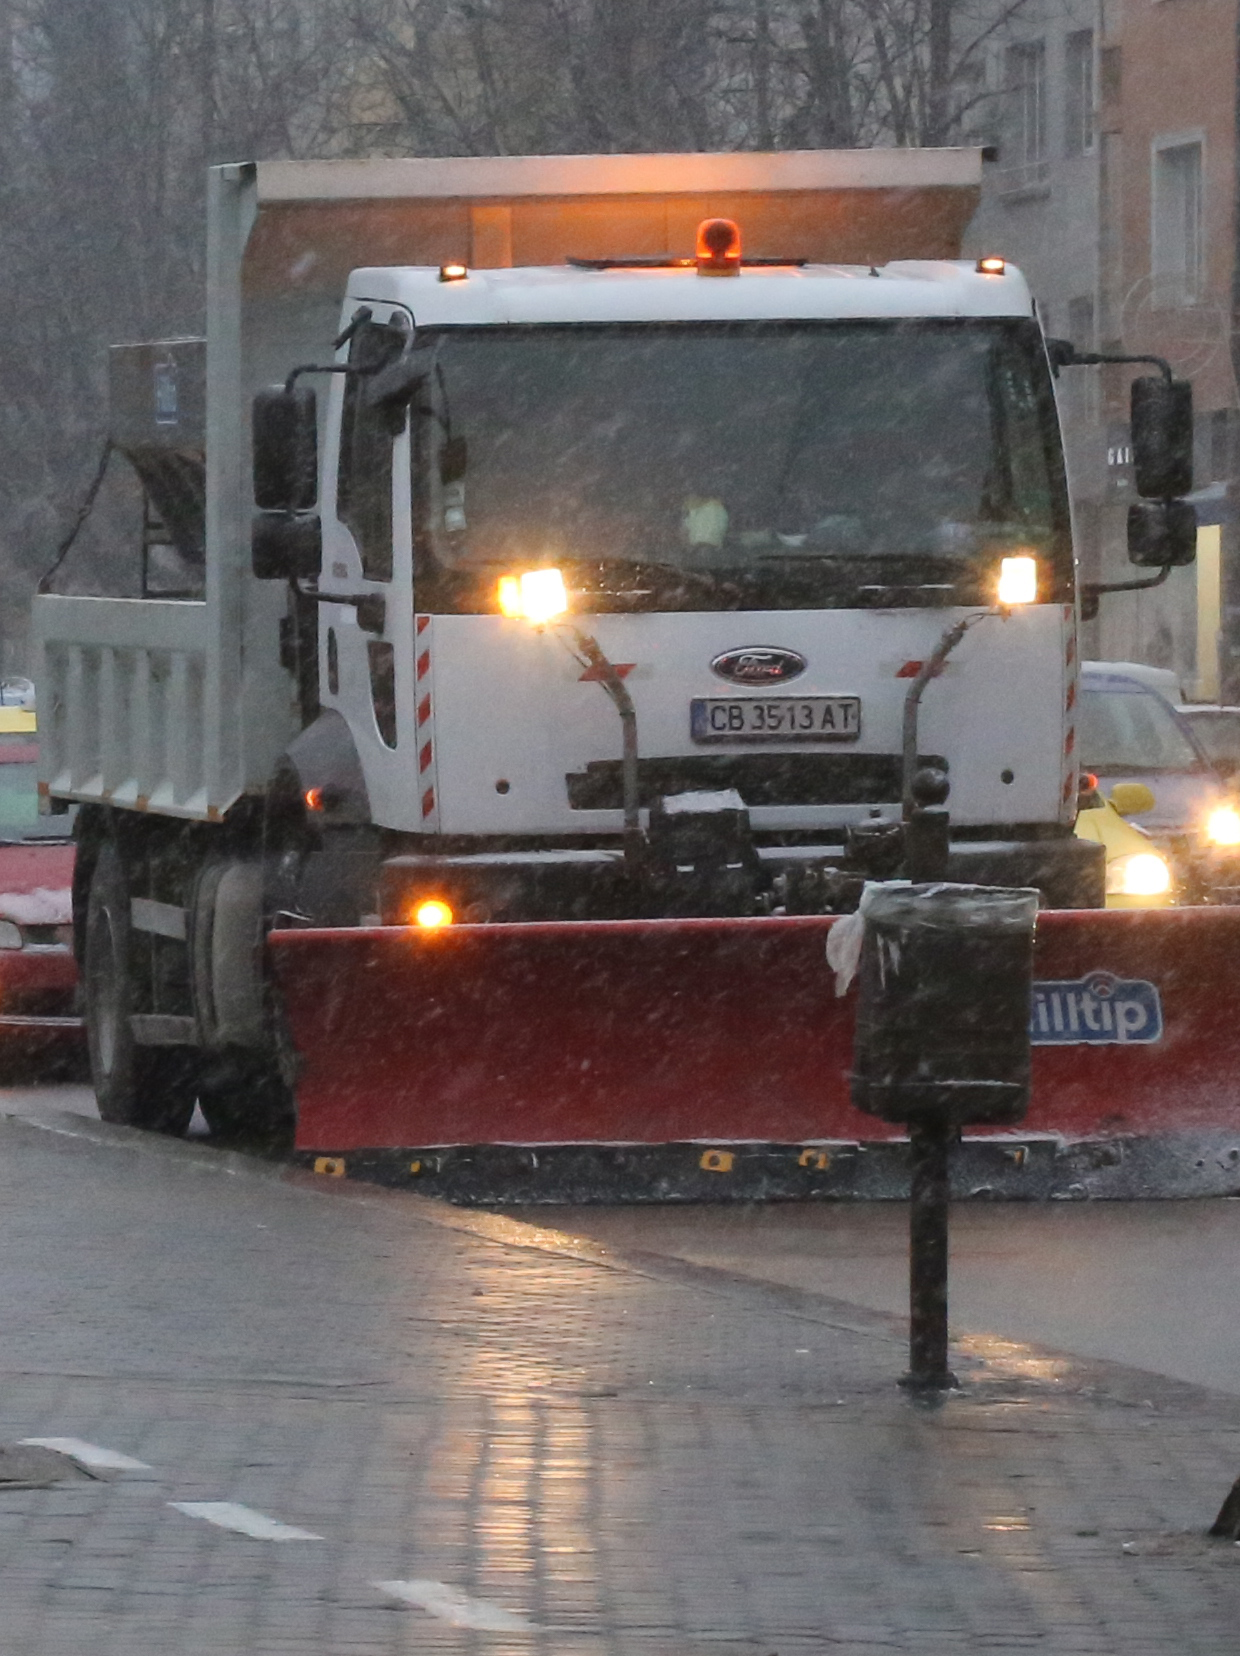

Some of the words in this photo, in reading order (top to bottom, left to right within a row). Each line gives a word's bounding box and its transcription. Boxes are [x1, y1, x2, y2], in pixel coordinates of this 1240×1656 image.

[734, 654, 784, 676] Ford
[711, 705, 744, 731] CB
[751, 704, 813, 731] 3513
[821, 703, 853, 730] AT
[1028, 992, 1148, 1040] illtip
